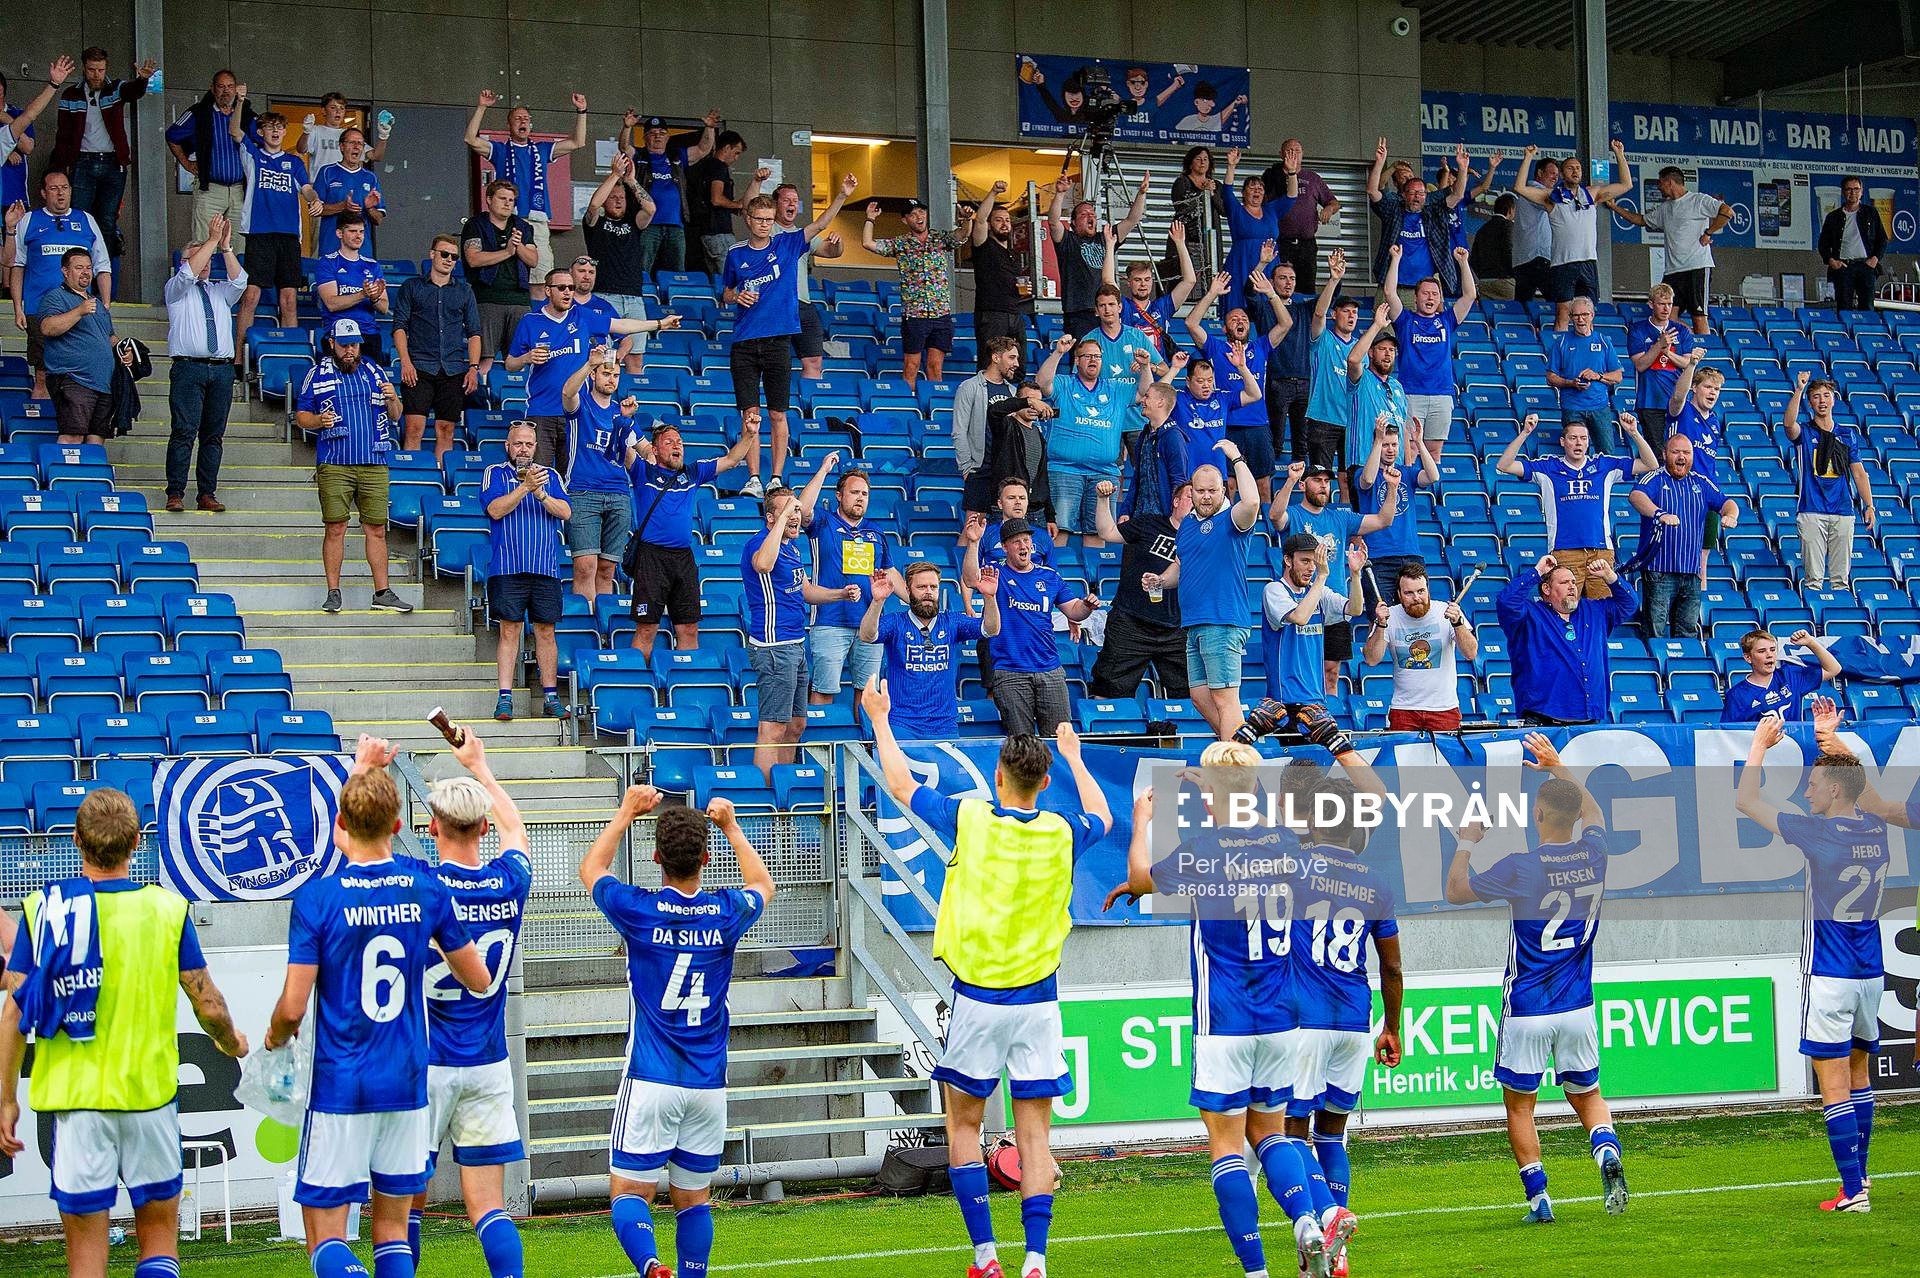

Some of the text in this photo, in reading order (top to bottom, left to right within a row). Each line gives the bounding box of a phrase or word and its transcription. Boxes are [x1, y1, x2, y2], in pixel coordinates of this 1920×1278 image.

[1127, 112, 1150, 124] 1921
[1421, 103, 1449, 130] AR
[1482, 106, 1530, 135] BAR
[1633, 114, 1679, 143] BAR
[1710, 118, 1761, 147] MAD
[1786, 123, 1831, 150] BAR
[1423, 144, 1449, 153] LYNGBY
[1857, 127, 1906, 154] MAD
[1654, 156, 1676, 165] LYNGBY
[1772, 162, 1790, 171] BETAL
[1845, 166, 1875, 175] MOBILEPAY
[1412, 333, 1441, 344] jönsson
[1566, 480, 1593, 495] HF
[905, 662, 949, 672] PENSION
[1539, 851, 1590, 863] blueenergy
[1852, 844, 1881, 859] HEBO
[229, 857, 322, 892] LYNGBY BK
[340, 875, 415, 889] blueenergy
[1548, 867, 1596, 887] TEKSEN
[1309, 875, 1376, 905] TSHIEMBE
[1832, 861, 1889, 923] 21
[343, 903, 422, 927] WINTHER
[657, 901, 721, 916] blueenergy
[1540, 882, 1604, 952] 27
[1233, 883, 1294, 961] 19
[652, 927, 724, 946] DA SILVA
[1305, 900, 1366, 973] 18
[361, 934, 406, 1023] 6
[660, 953, 711, 1027] 4
[1372, 1065, 1458, 1096] Henrik
[1284, 1185, 1304, 1198] 1921
[1329, 1182, 1347, 1193] 1921
[685, 1260, 706, 1270] 1921
